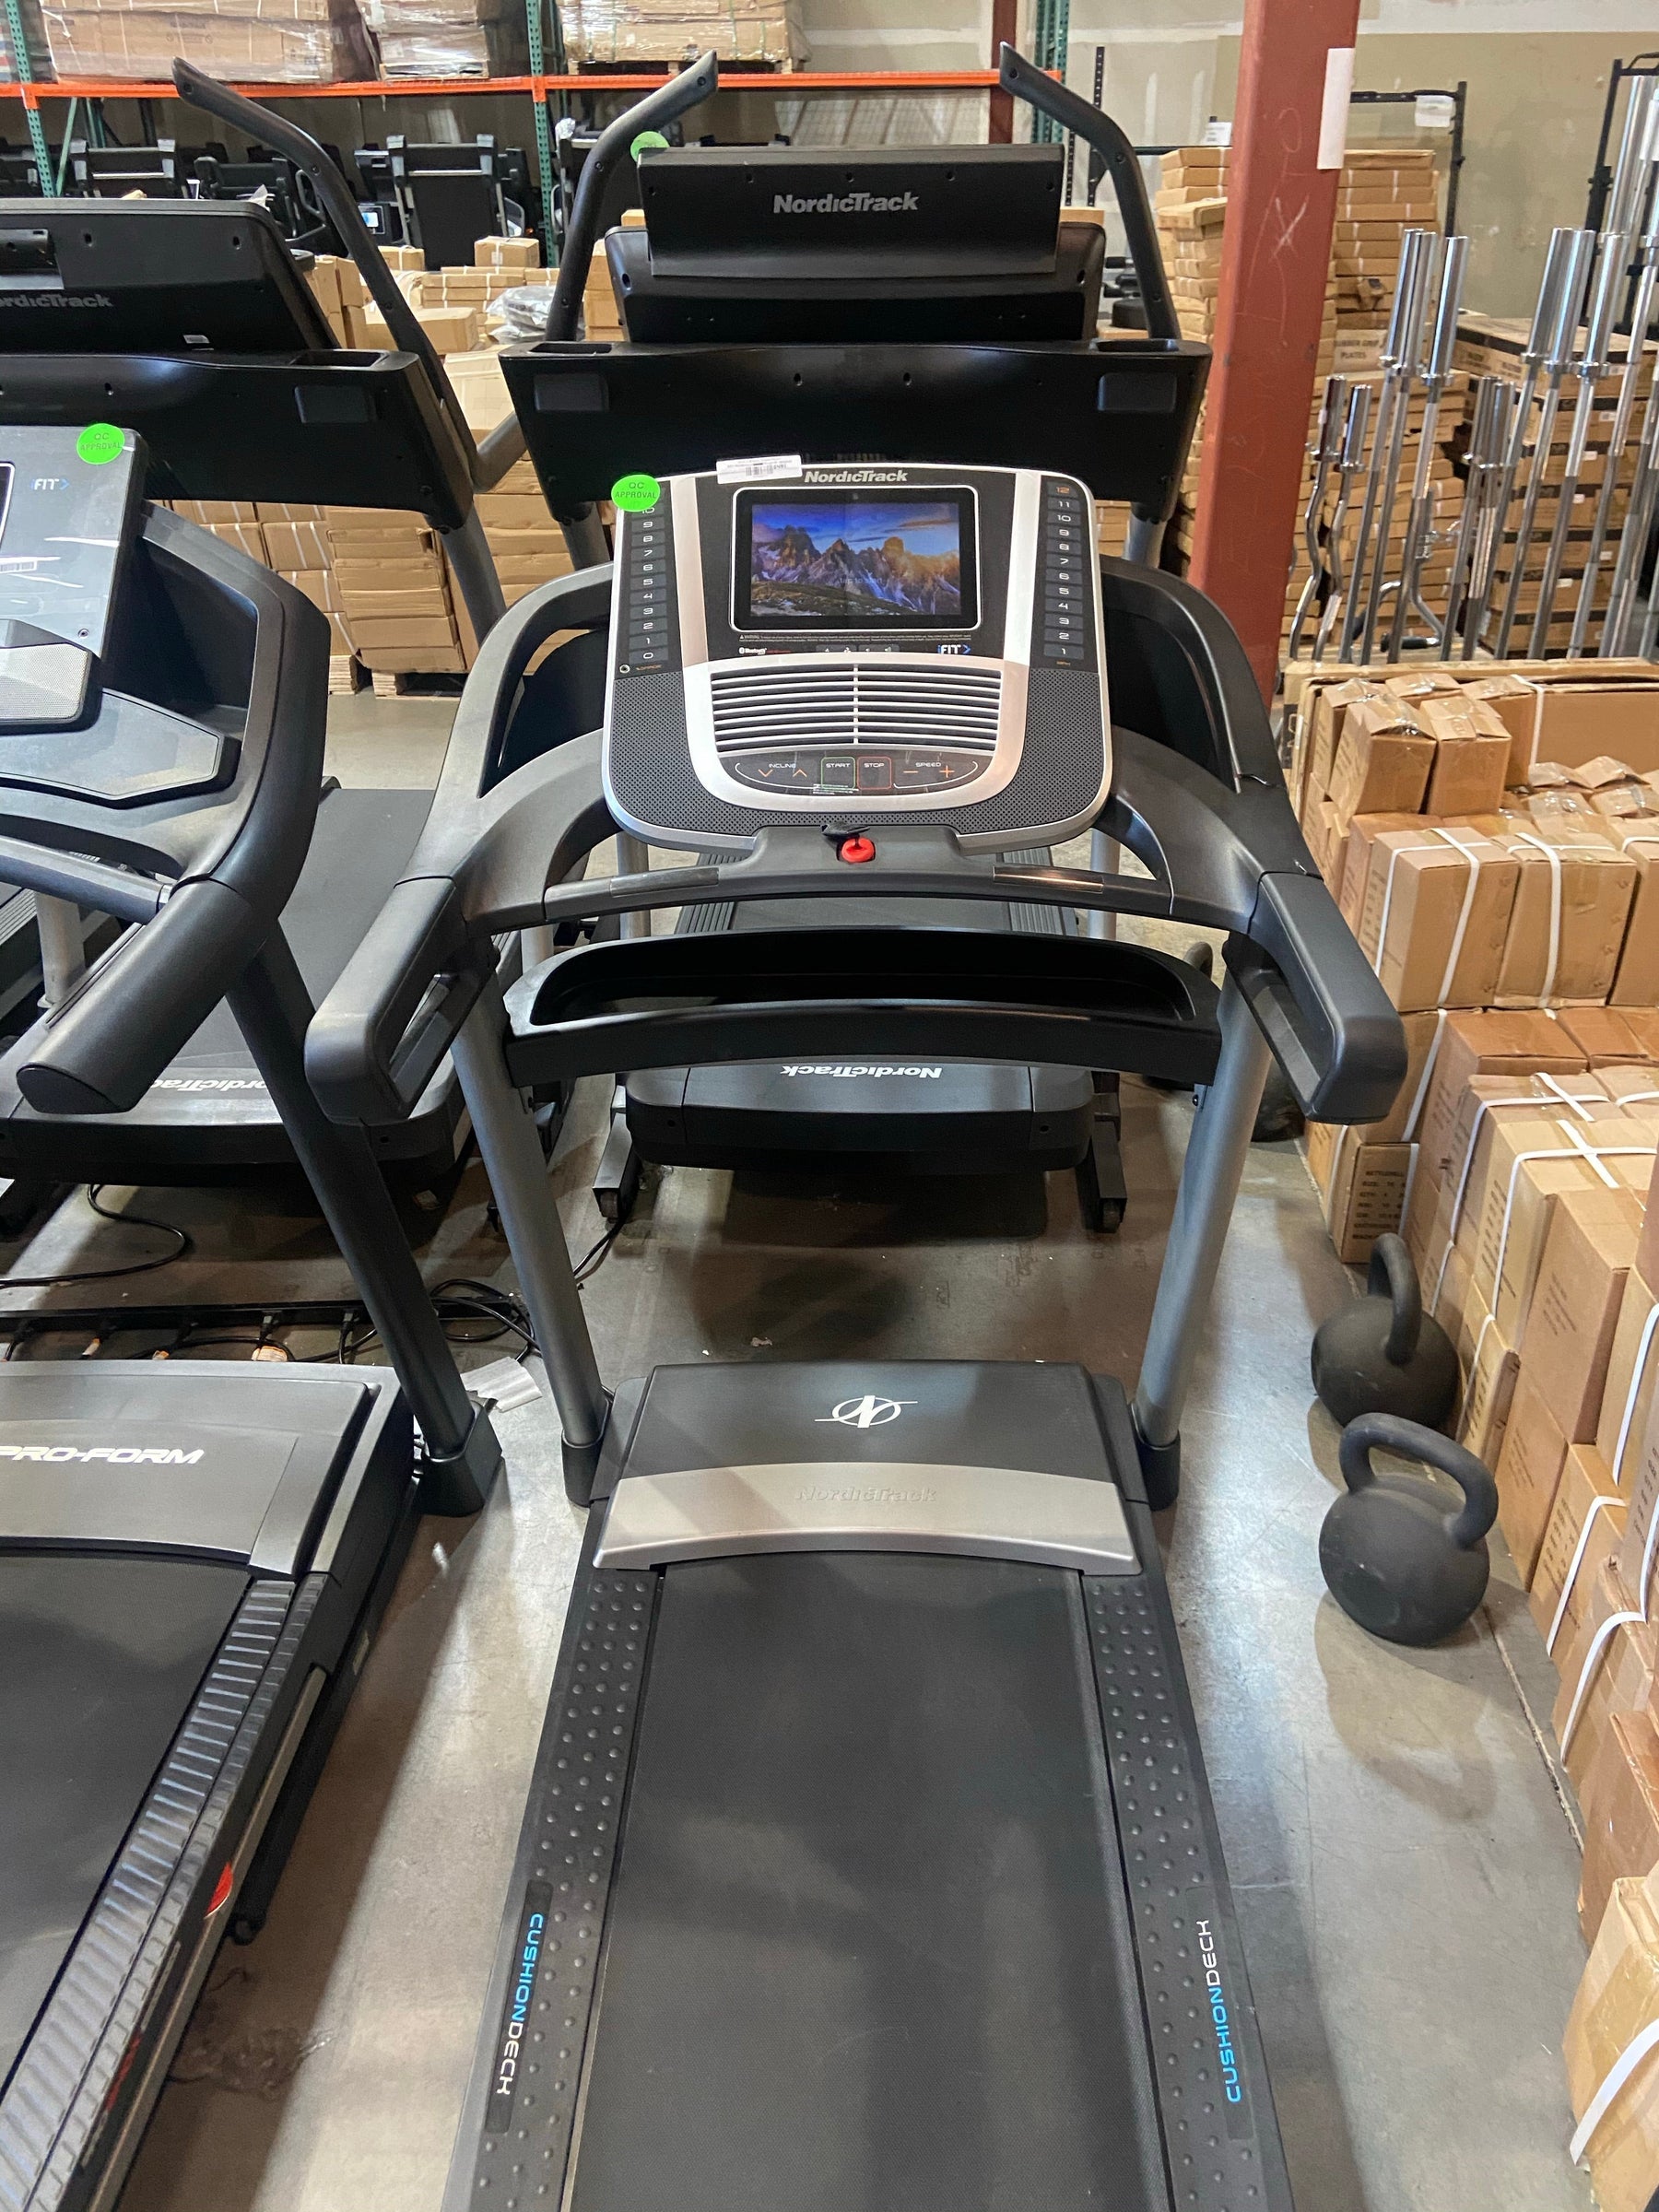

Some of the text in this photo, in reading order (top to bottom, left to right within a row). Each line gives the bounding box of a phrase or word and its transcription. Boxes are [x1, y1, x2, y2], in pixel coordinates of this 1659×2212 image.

[773, 192, 920, 214] NordicTrack
[94, 432, 110, 441] QC
[80, 441, 122, 452] APPROVAL
[804, 469, 908, 483] NordicTrack
[629, 481, 645, 489] QC
[1056, 486, 1070, 494] 12
[615, 491, 657, 500] APPROVAL
[1059, 500, 1070, 509] 11
[1057, 514, 1072, 523] 10
[642, 520, 653, 528] 9
[642, 535, 653, 543] 8
[1059, 543, 1070, 551] 8
[642, 563, 653, 571] 6
[1059, 572, 1070, 581] 6
[642, 578, 653, 586] 5
[1059, 587, 1069, 595] 5
[1058, 602, 1069, 610] 4
[642, 622, 653, 630] 2
[1059, 632, 1070, 641] 2
[937, 645, 962, 654] iFIT
[642, 652, 653, 660] 0
[781, 1065, 942, 1078] NordicTrack
[0, 1445, 205, 1465] PRO-FORM
[795, 1487, 937, 1503] NordicTrack
[496, 1912, 544, 2096] CUSHIONDECK
[1196, 1919, 1241, 2103] CUSHIONDECK
